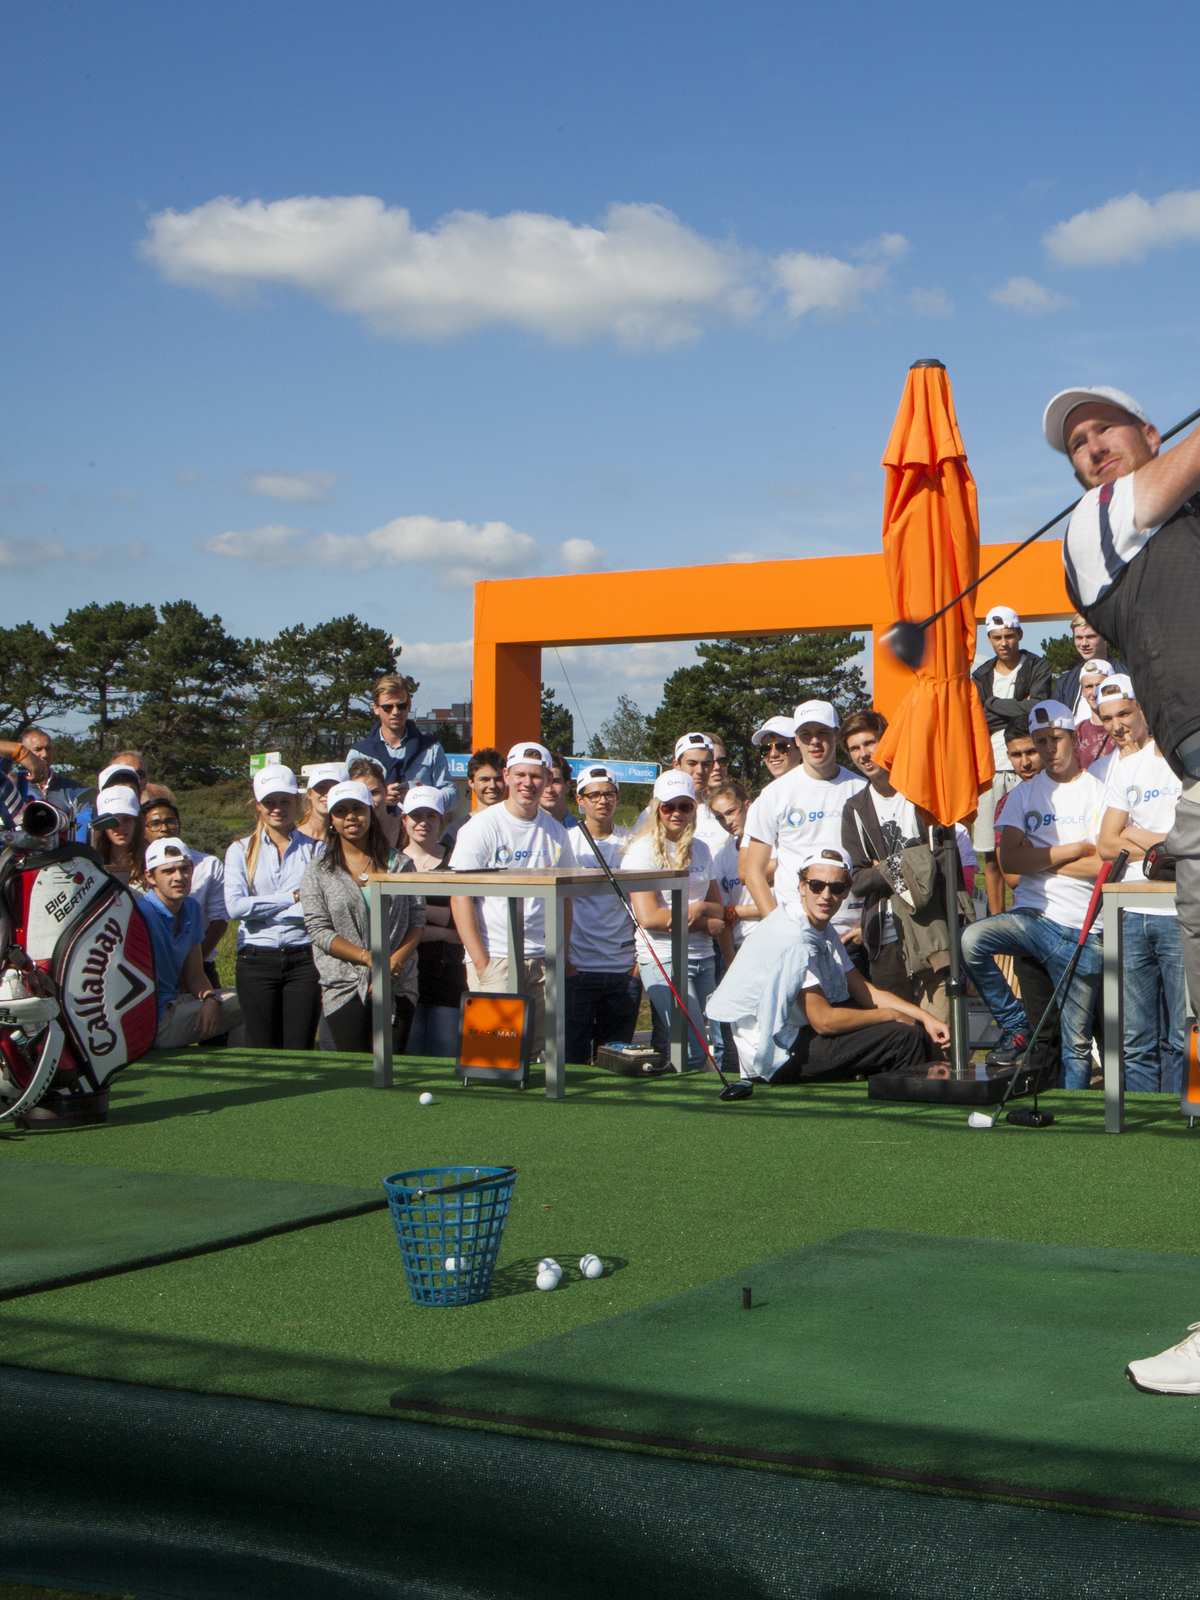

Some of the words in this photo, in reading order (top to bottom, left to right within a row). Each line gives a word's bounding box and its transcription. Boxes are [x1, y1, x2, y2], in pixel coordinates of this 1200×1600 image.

[628, 768, 654, 777] Plastic
[808, 810, 843, 822] goGOL
[45, 891, 68, 915] BIG
[54, 876, 95, 923] BERTHA
[74, 917, 124, 1057] Callaway
[468, 1028, 517, 1038] TRACKMAN
